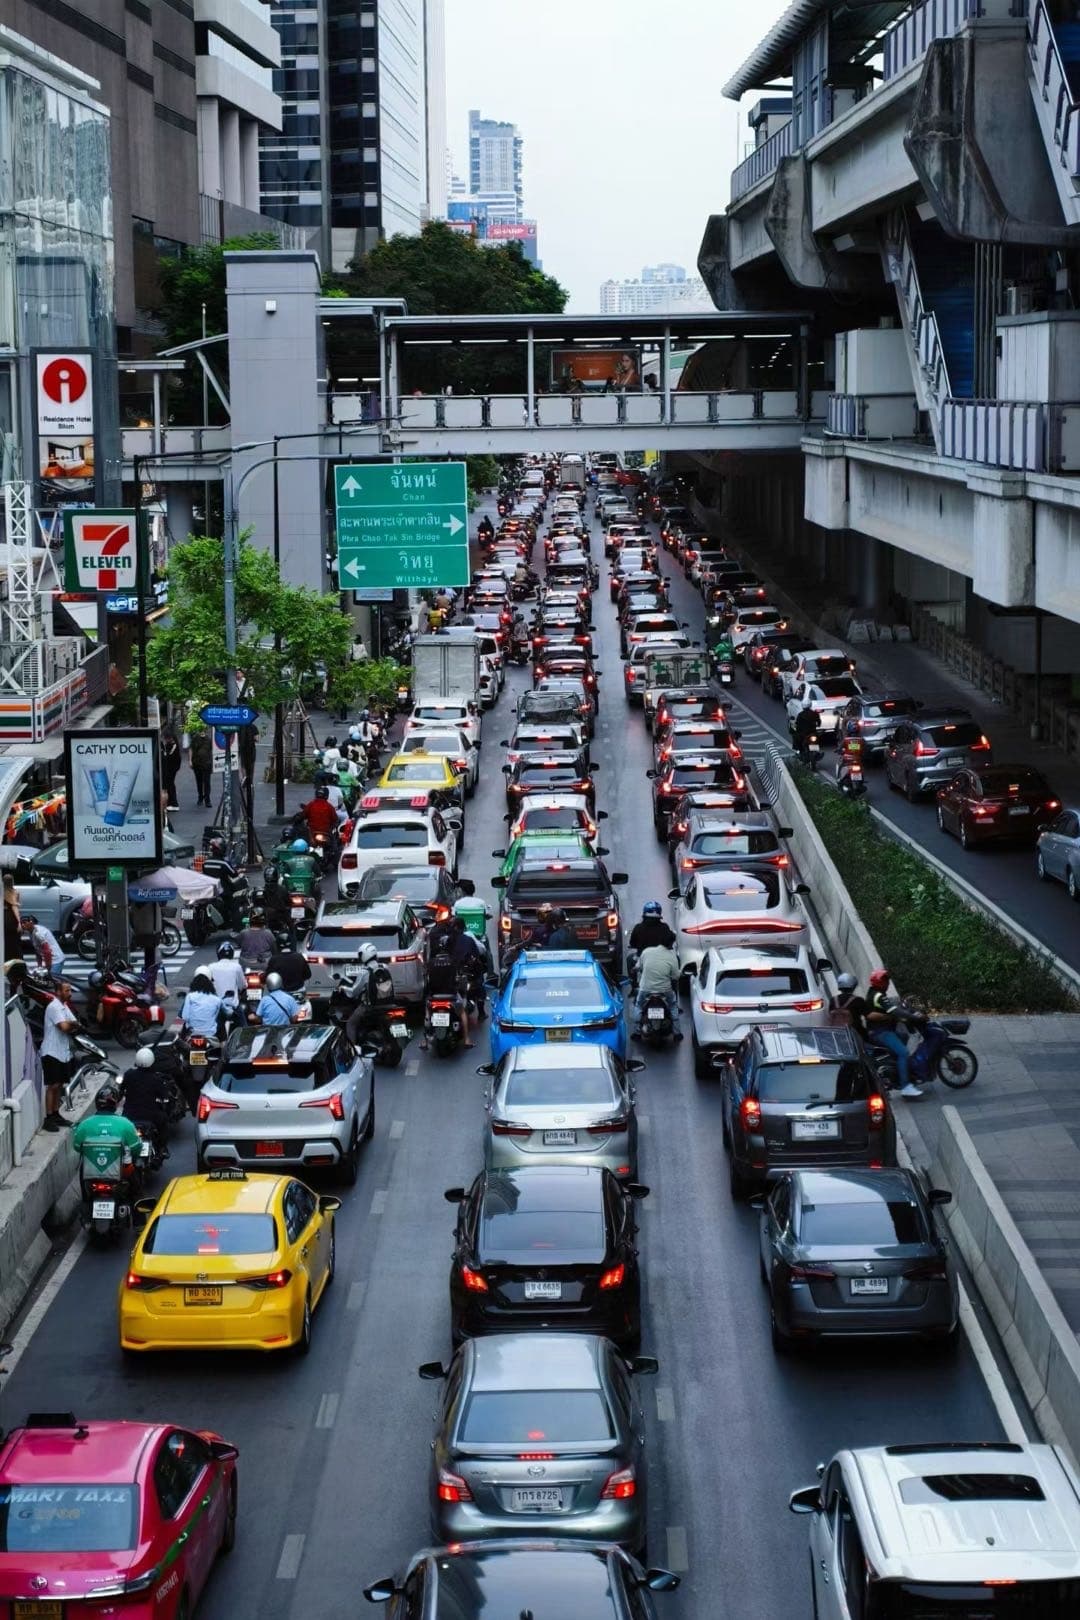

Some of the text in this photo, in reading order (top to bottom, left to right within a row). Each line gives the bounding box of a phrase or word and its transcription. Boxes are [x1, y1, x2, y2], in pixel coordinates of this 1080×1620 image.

[493, 227, 524, 235] SHARP
[390, 469, 439, 488] จันทน์
[402, 493, 425, 501] Chan
[340, 513, 441, 528] สะพานพระเจ้าตากสิน
[341, 535, 359, 543] Phra
[401, 533, 413, 541] Sin
[416, 532, 441, 542] Bridge
[82, 524, 130, 590] 7
[399, 551, 433, 573] วิทยุ
[395, 575, 439, 584] Witthayu
[242, 709, 249, 719] 3
[76, 744, 148, 755] CATHY DOLL
[83, 825, 115, 835] กันแดด
[75, 1487, 128, 1503] TAXI
[537, 1491, 558, 1500] 8725
